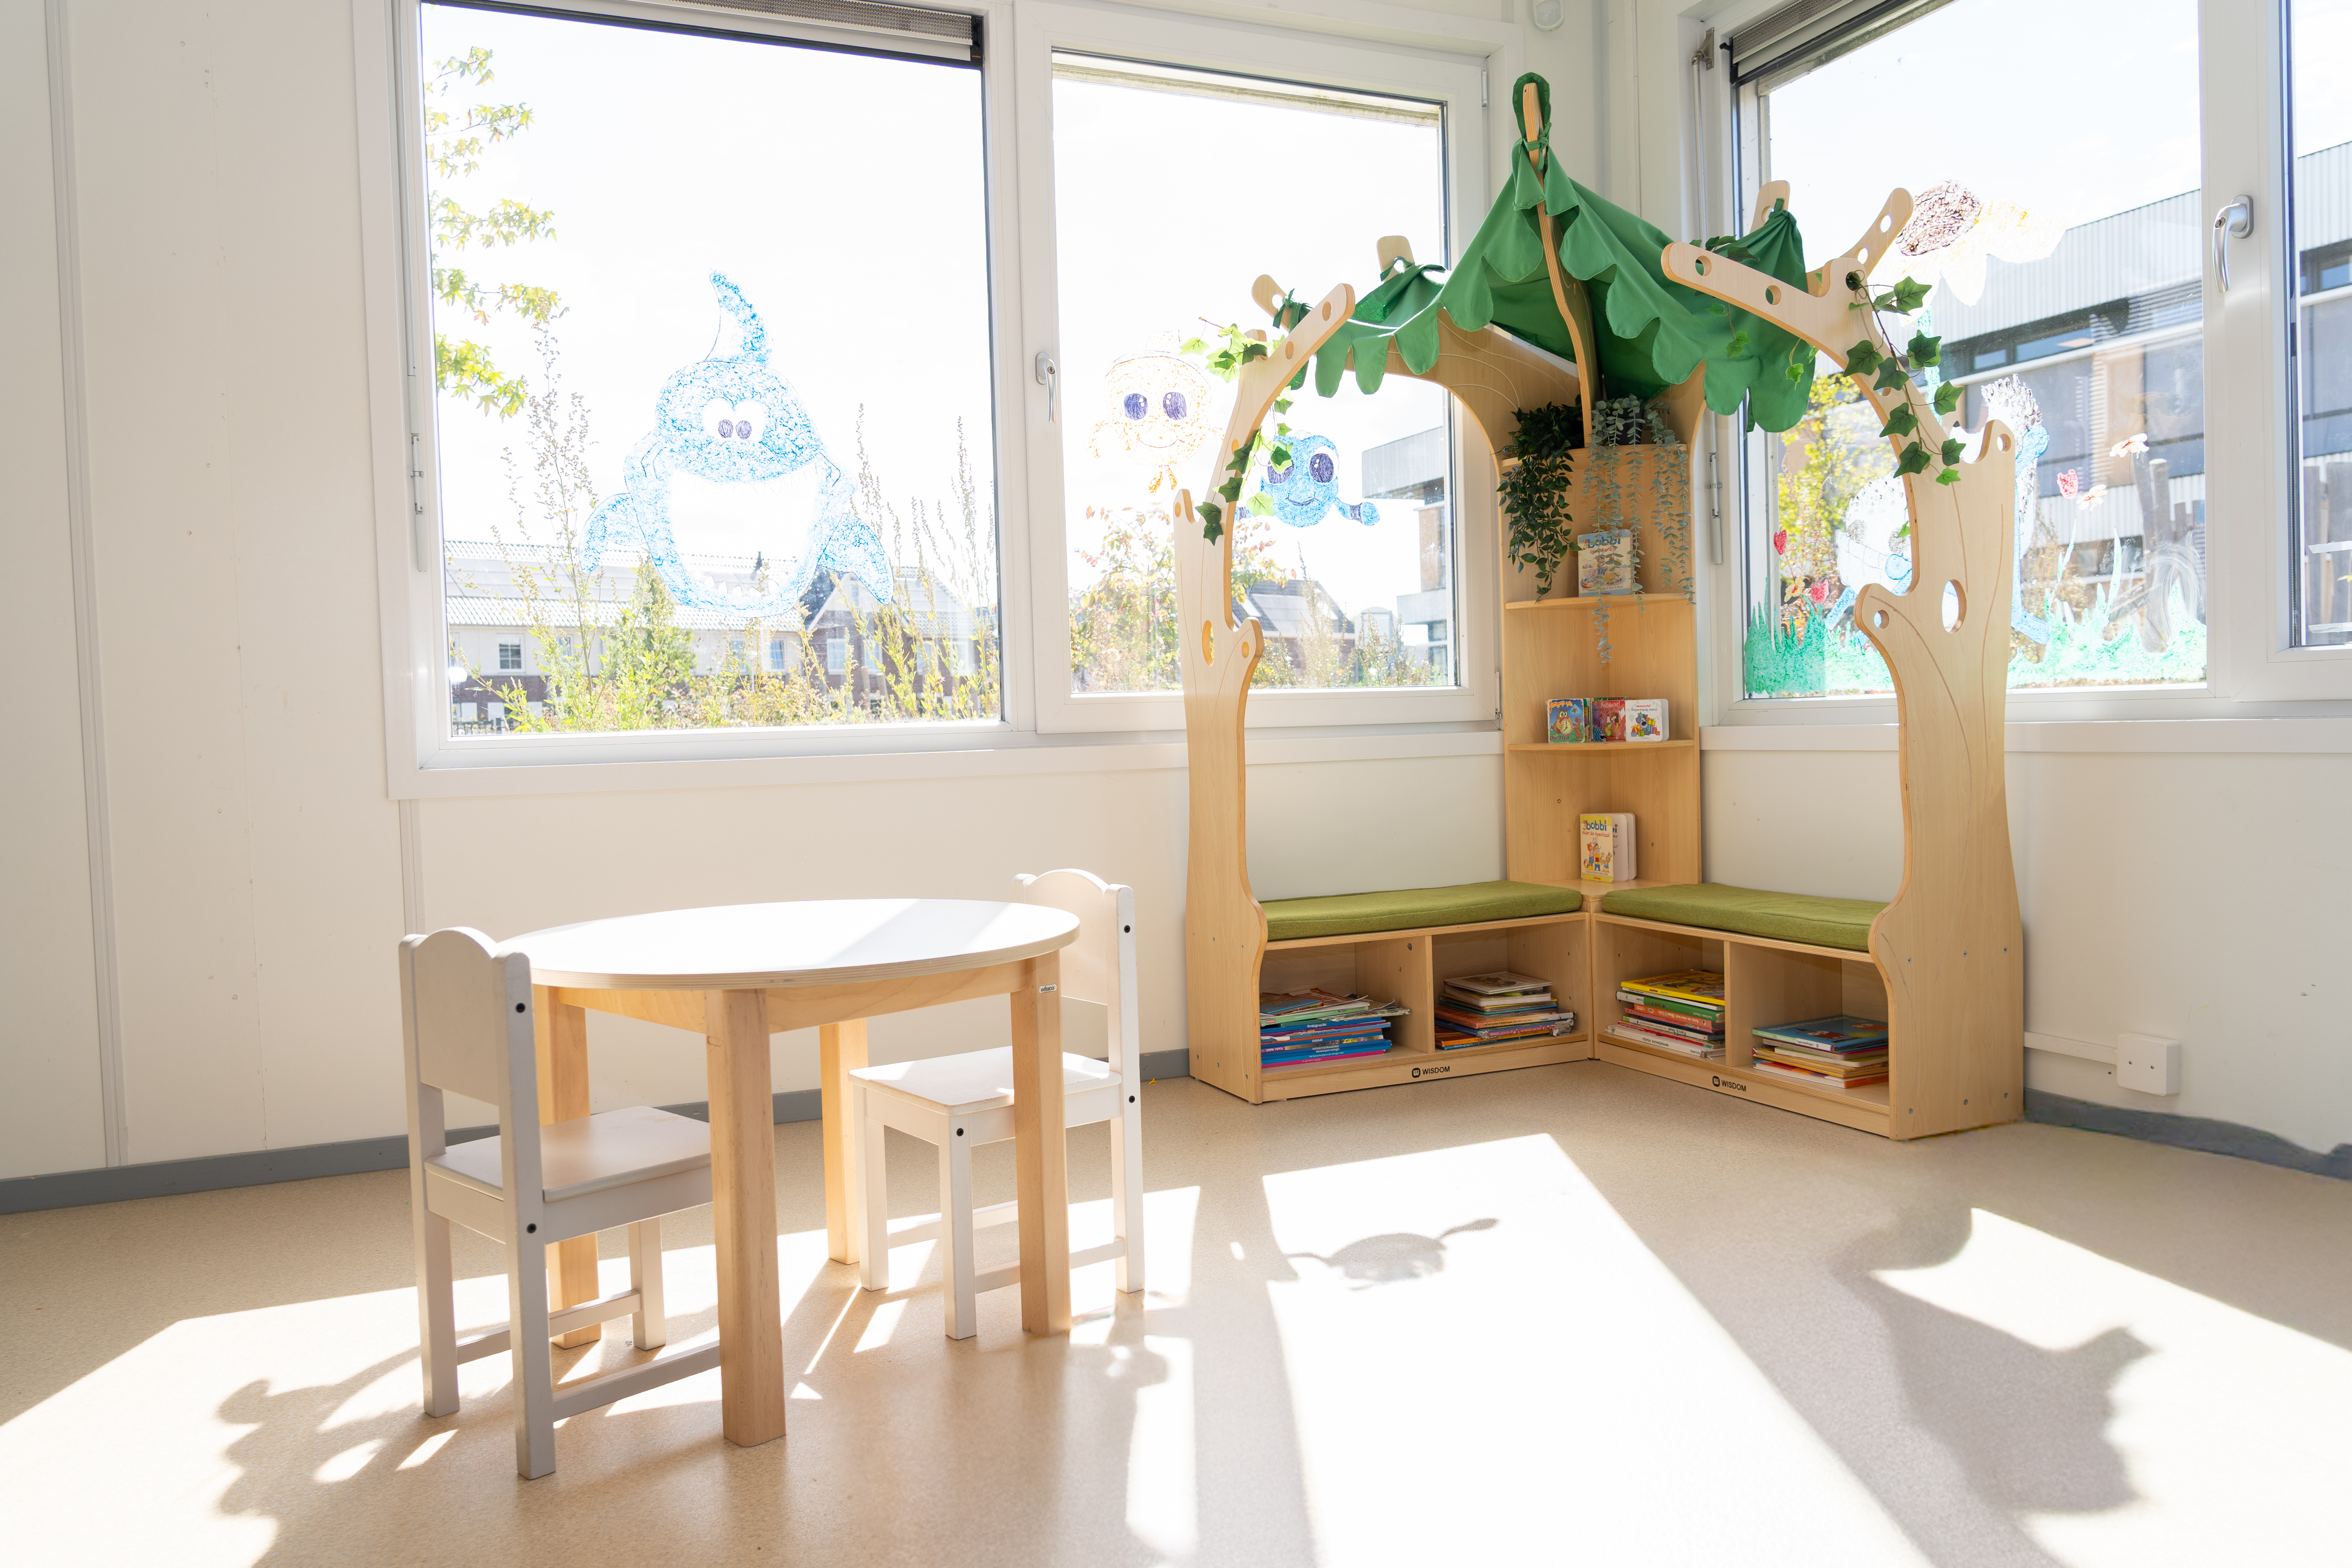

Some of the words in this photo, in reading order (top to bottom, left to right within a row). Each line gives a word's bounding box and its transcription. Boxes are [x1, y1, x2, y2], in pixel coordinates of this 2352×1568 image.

[1586, 819, 1607, 831] bobbi
[1777, 1035, 1796, 1043] TEGENSTELL
[1422, 1066, 1450, 1075] WISDOM
[1721, 1079, 1747, 1092] WISDOM
